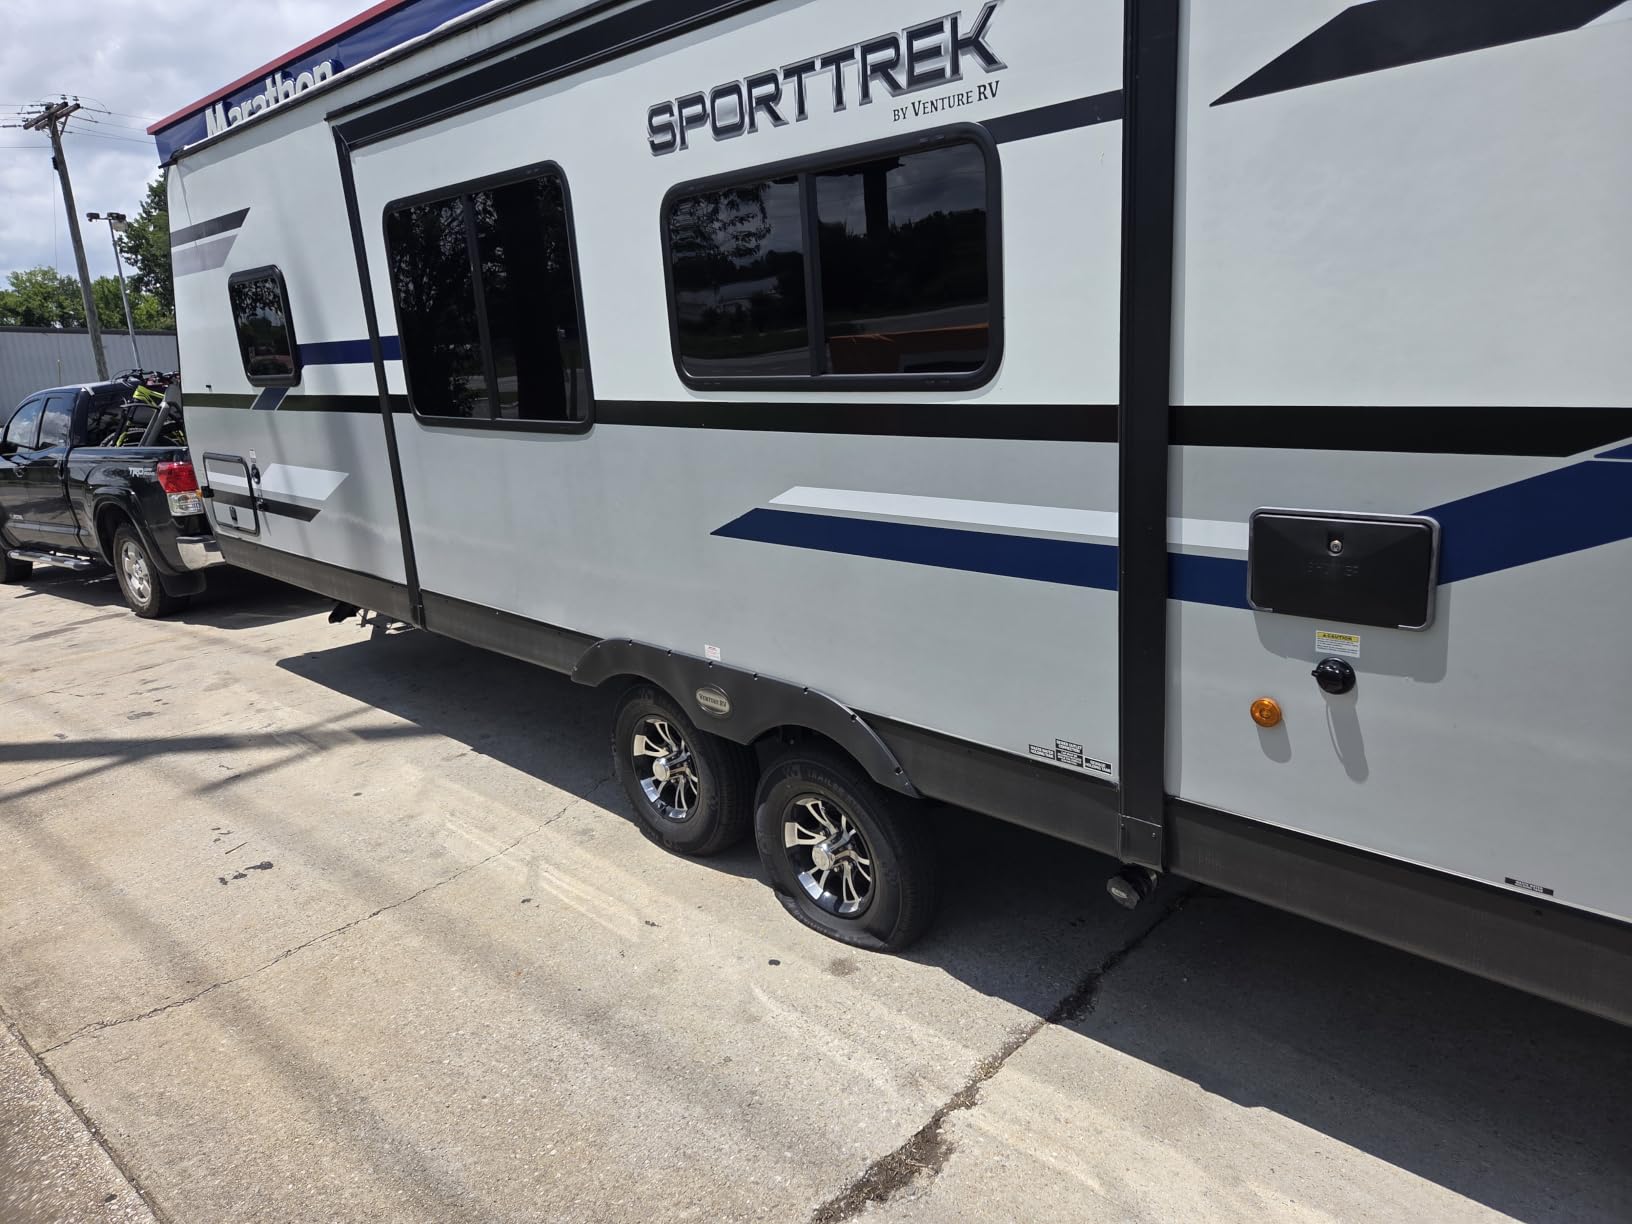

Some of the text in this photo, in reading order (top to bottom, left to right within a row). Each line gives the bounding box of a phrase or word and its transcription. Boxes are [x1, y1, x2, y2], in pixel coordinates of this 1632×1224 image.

[205, 59, 333, 137] Marathon
[647, 1, 1008, 157] SPORTTREK
[893, 80, 1000, 122] BY VENTURE RV
